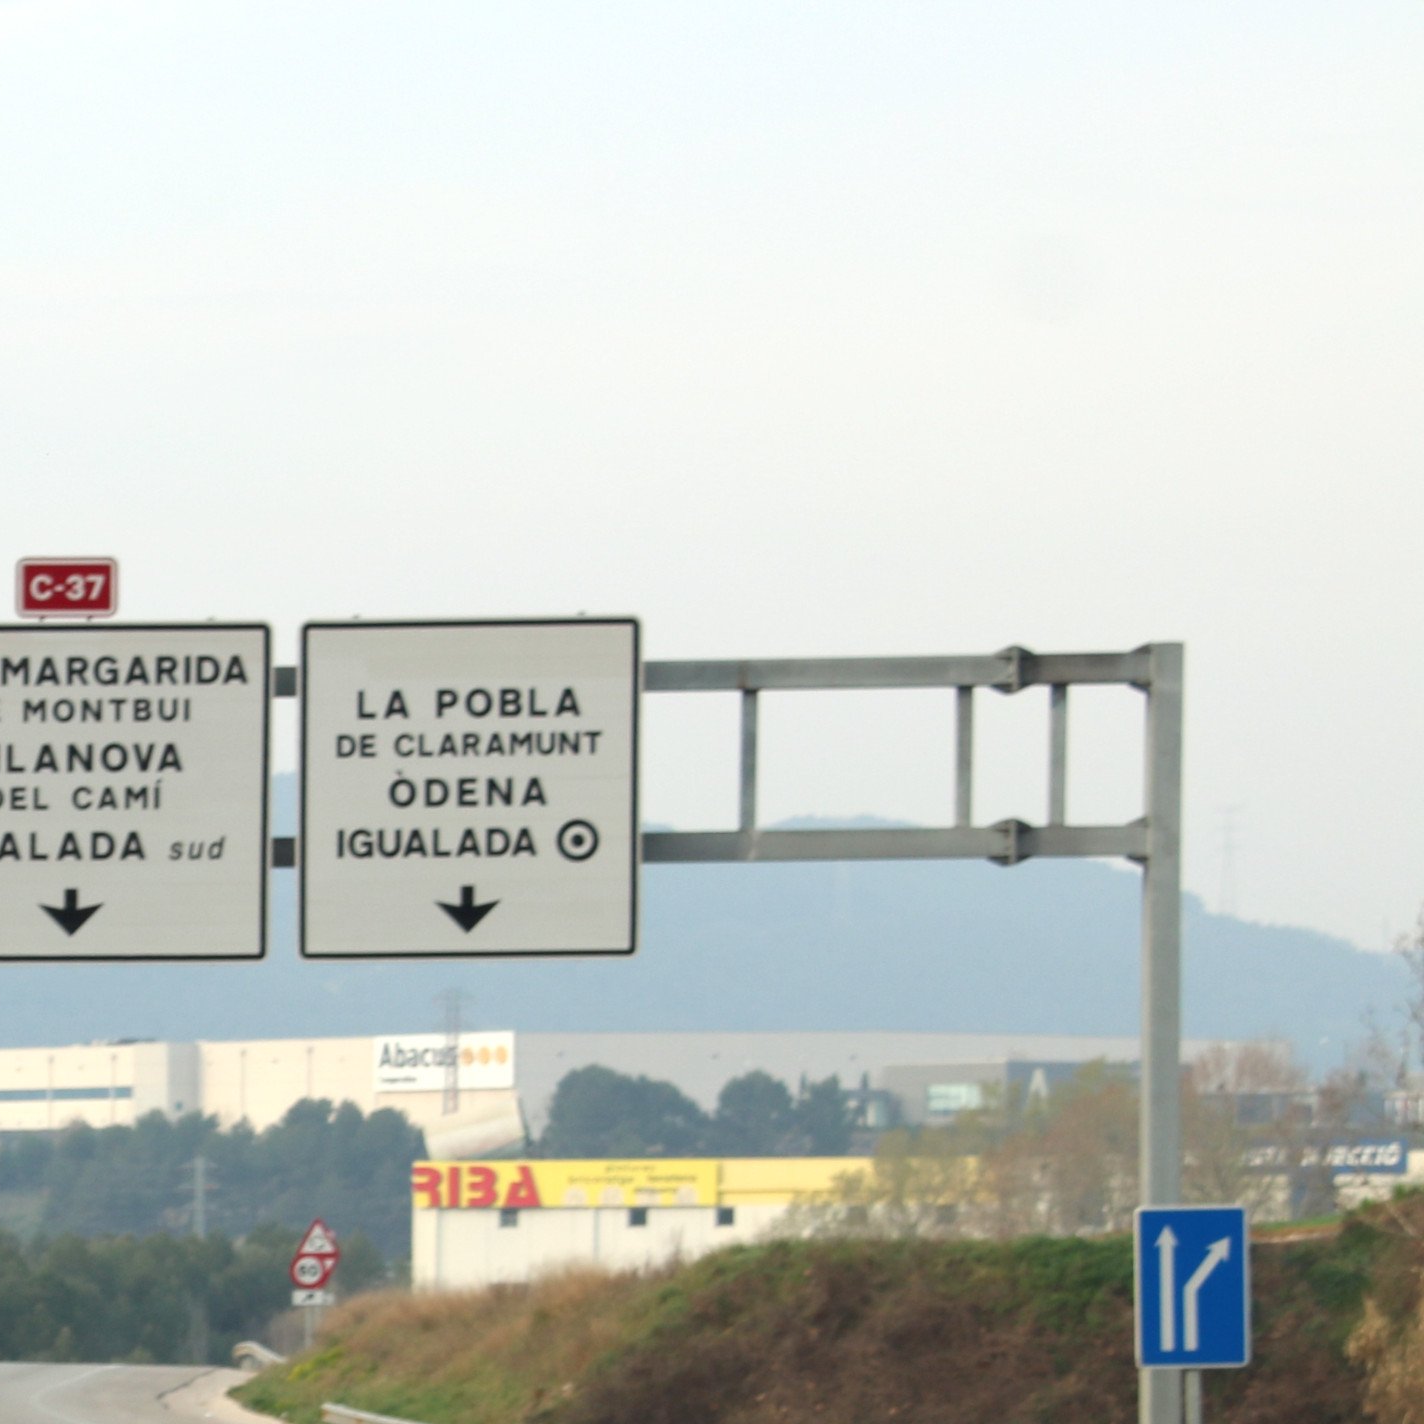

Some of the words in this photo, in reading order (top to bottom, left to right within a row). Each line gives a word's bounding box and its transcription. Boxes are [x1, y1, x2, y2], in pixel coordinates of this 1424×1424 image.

[28, 573, 107, 602] C-37
[0, 655, 250, 687] MARGARIDA
[22, 698, 193, 724] MONTBUI
[356, 689, 410, 720] LA
[435, 686, 582, 719] POBLA
[335, 733, 378, 759] DE
[393, 730, 604, 759] CLARAMUNT
[71, 777, 163, 812] CAMÍ
[388, 768, 549, 809] ÒDENA
[167, 836, 228, 862] sud
[335, 826, 538, 859] IGUALADA
